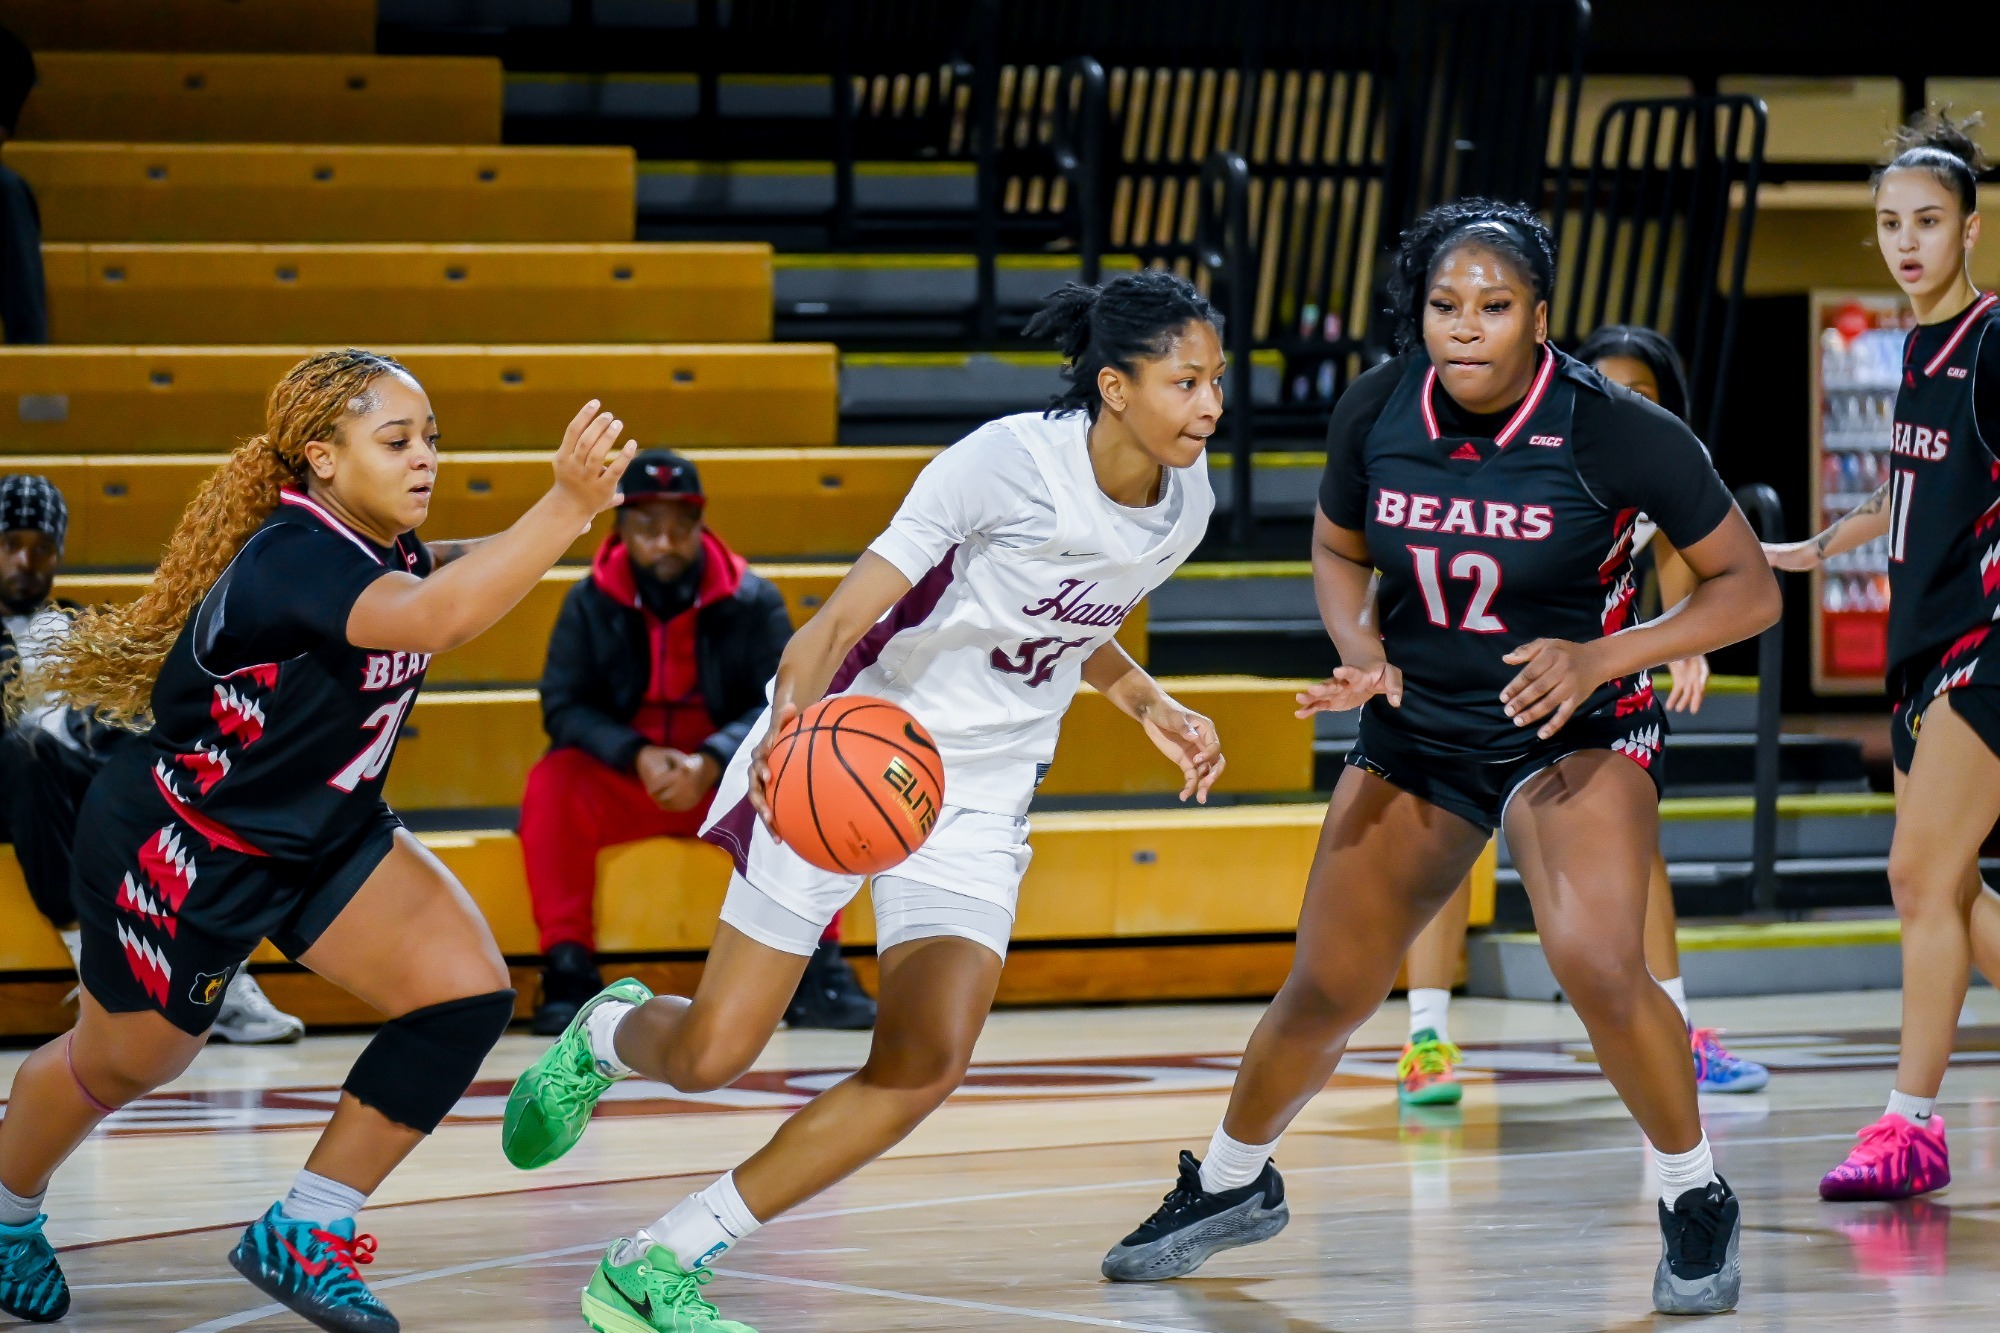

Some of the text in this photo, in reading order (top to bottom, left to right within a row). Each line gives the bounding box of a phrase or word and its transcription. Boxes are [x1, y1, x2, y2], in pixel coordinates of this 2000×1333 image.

[1529, 435, 1564, 448] CACC
[1375, 488, 1554, 541] BEARS
[1405, 544, 1508, 634] 12
[882, 756, 938, 837] ELITE
